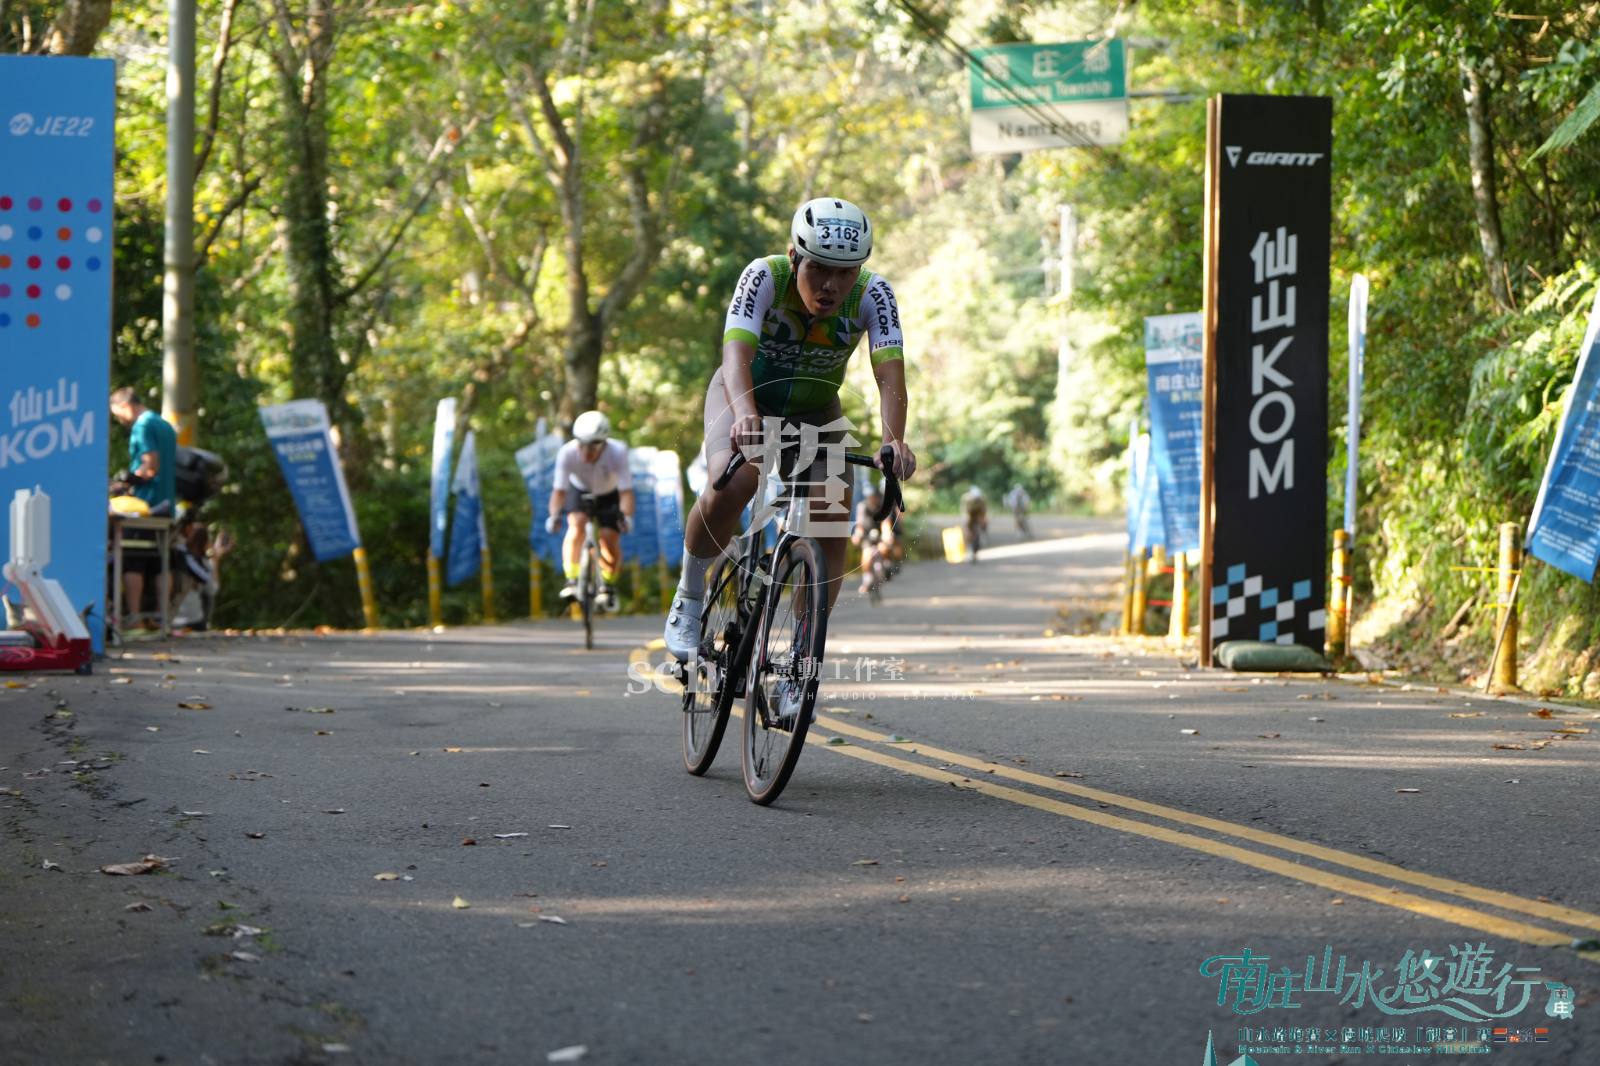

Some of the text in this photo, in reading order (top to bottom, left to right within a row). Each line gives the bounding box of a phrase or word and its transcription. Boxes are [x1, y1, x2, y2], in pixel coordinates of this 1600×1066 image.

[34, 116, 95, 136] JE22
[1246, 152, 1324, 166] GIANT
[821, 227, 859, 243] 3162
[731, 268, 755, 316] MAJOR
[743, 269, 767, 320] TAYLOR
[868, 286, 889, 336] TAYLOR
[877, 281, 899, 330] MAJOR
[8, 377, 79, 427] 仙山
[0, 411, 95, 468] KOM
